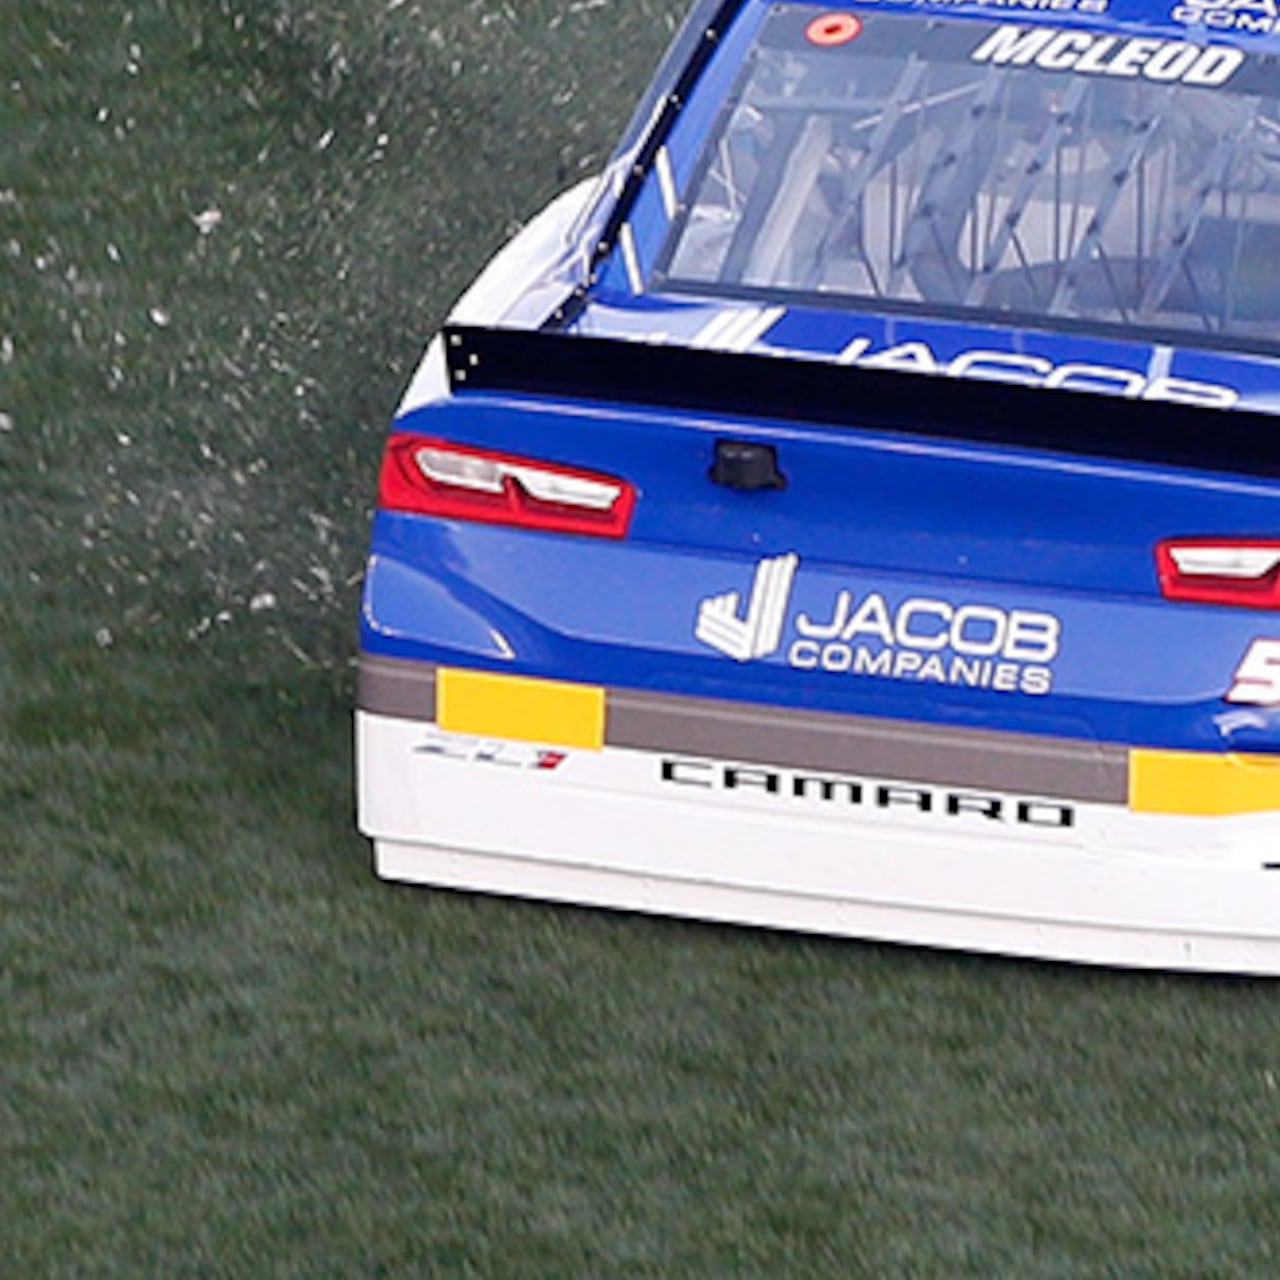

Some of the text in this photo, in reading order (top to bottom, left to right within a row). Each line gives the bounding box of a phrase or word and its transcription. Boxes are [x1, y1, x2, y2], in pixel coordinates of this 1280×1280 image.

[971, 24, 1246, 86] MCLEOD
[796, 590, 1061, 663] JACOB
[787, 639, 1052, 695] COMPANIES
[660, 759, 1075, 827] CAMARO
